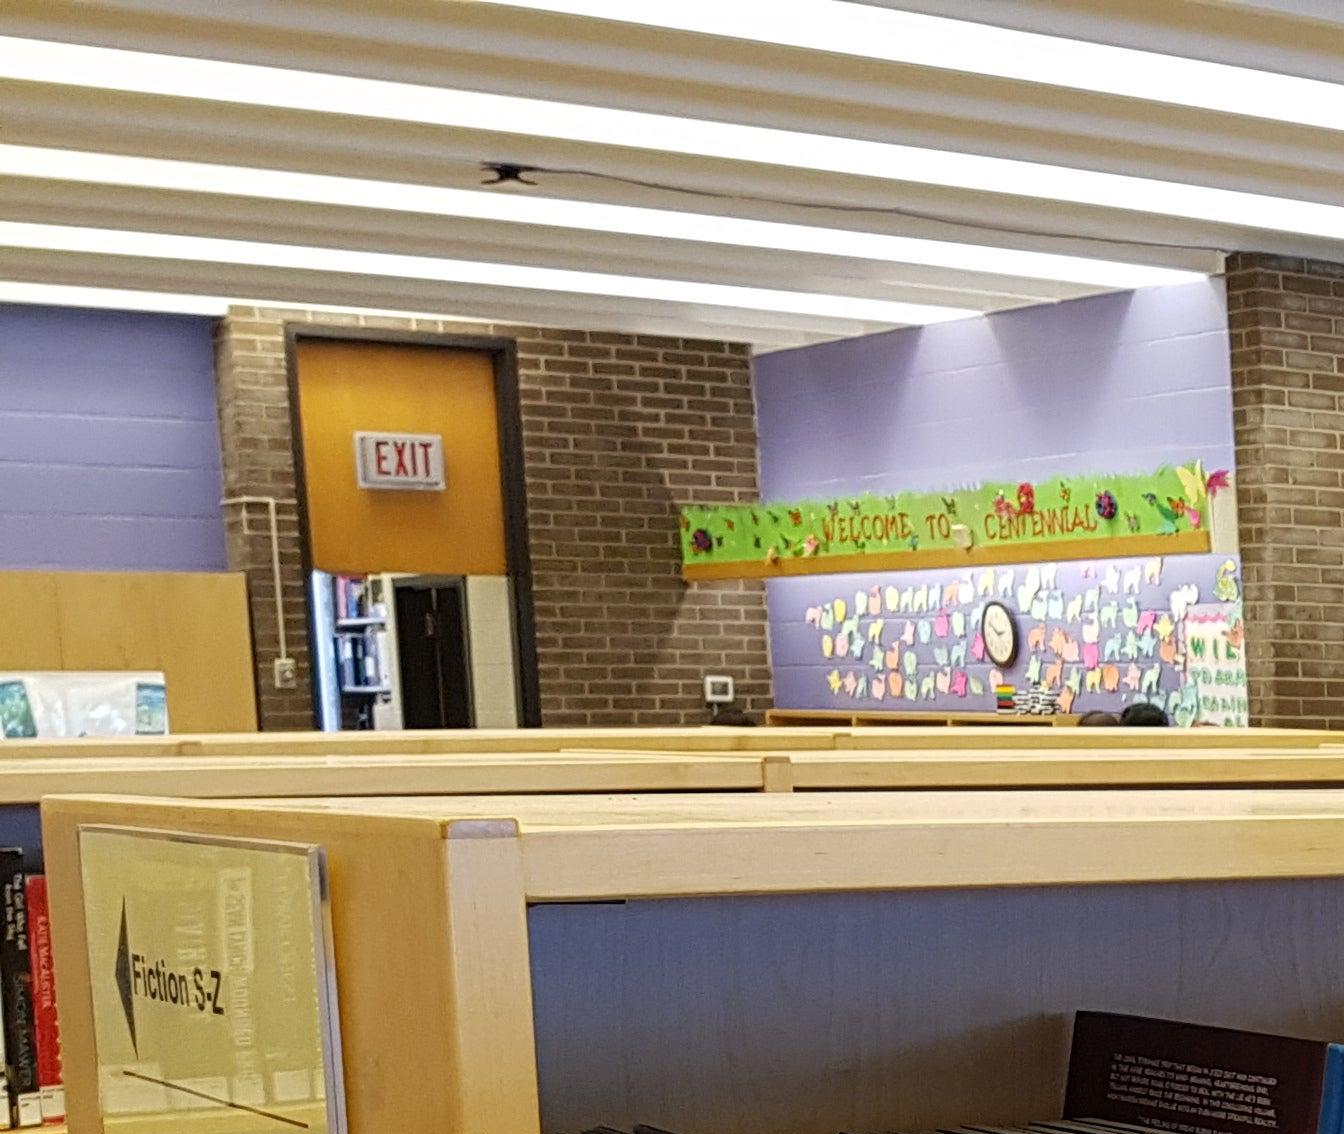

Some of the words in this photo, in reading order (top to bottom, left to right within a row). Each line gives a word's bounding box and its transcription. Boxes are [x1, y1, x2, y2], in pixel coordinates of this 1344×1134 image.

[376, 442, 432, 477] EXIT
[823, 516, 912, 543] WELCOME
[926, 515, 950, 539] TO
[984, 503, 1097, 538] CENTENNIAL
[132, 953, 191, 1008] Fiction
[194, 968, 225, 1016] S-Z
